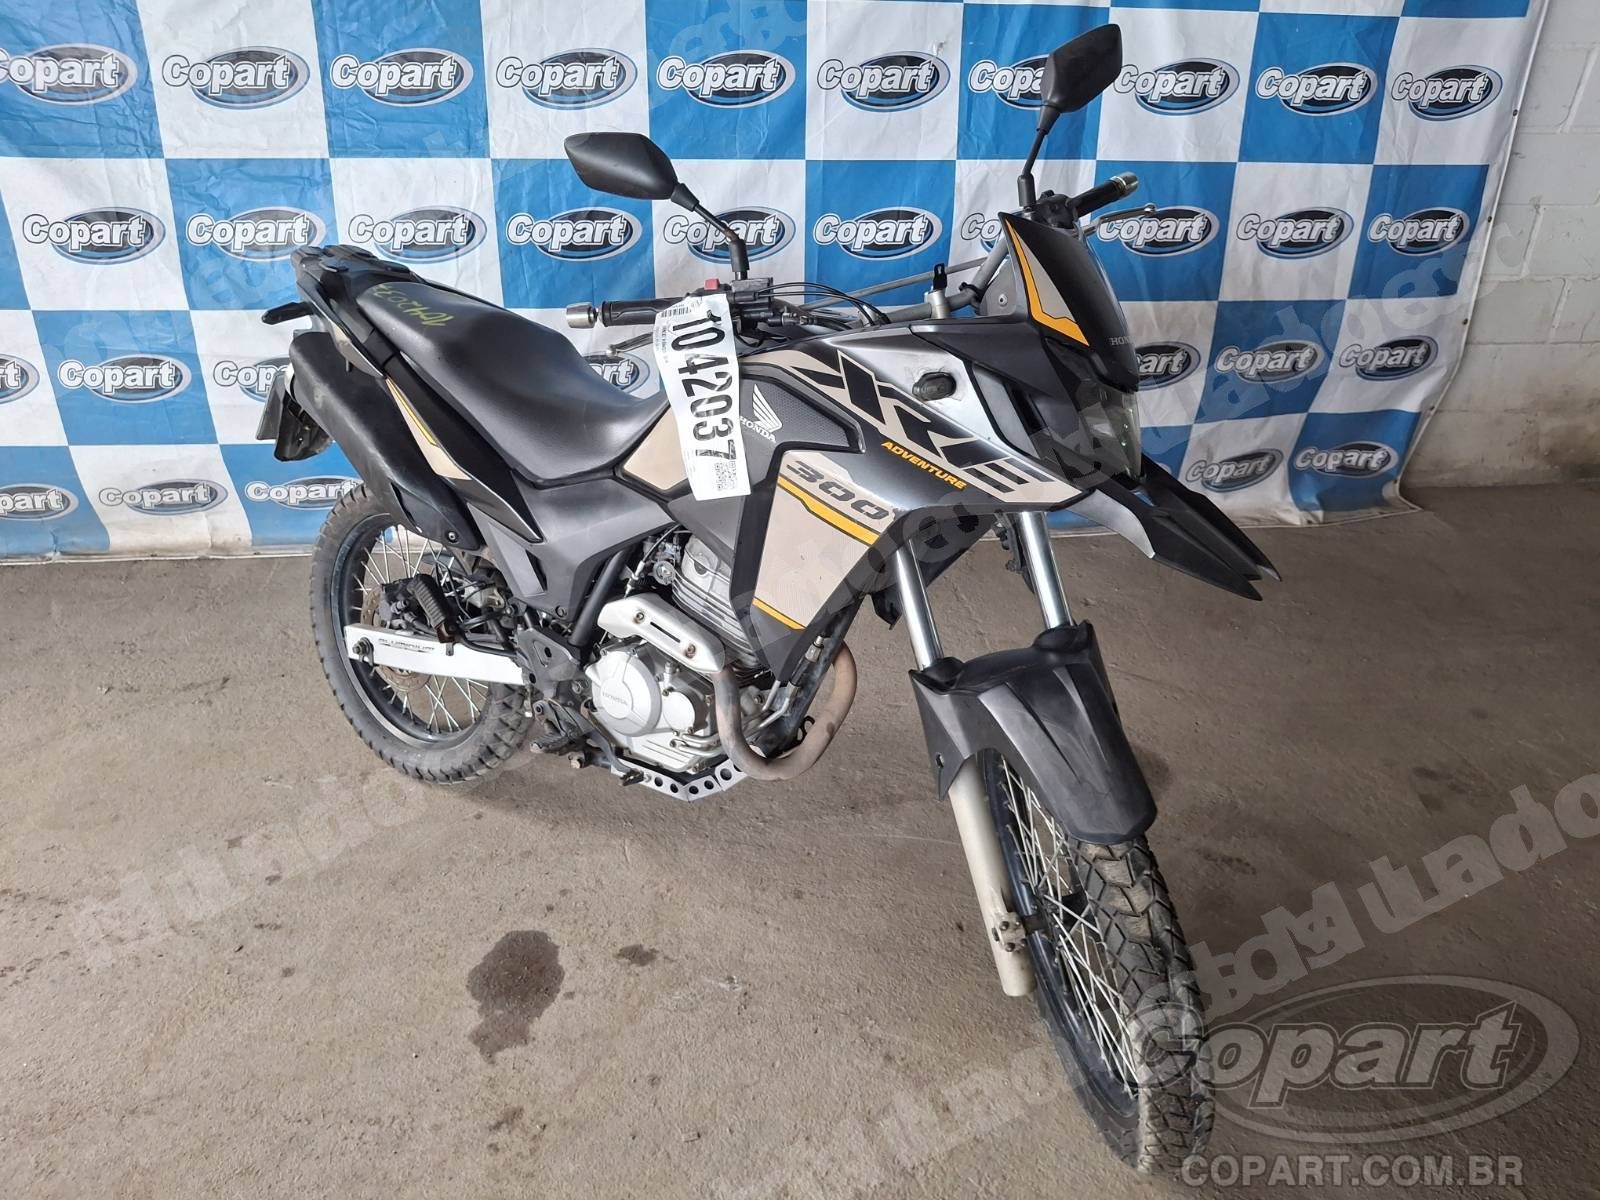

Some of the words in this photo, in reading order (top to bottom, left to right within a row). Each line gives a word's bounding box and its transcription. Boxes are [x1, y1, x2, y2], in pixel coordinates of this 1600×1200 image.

[162, 54, 291, 95] Copart
[330, 55, 457, 96] Copart
[496, 56, 618, 96] Copart
[656, 56, 780, 97] Copart
[817, 59, 935, 99] Copart
[968, 60, 1044, 100] Copa
[1113, 64, 1226, 102] Copart
[1255, 67, 1369, 106] Copart
[1391, 72, 1488, 109] Copart
[23, 214, 145, 251] Copart
[186, 213, 310, 252] Copart
[348, 214, 469, 251] Copart
[506, 213, 627, 251] Copart
[813, 213, 930, 251] Copart
[1097, 214, 1208, 248] Copart
[1236, 213, 1342, 247] Copart
[1368, 213, 1463, 248] Copart
[58, 359, 177, 393] Copart
[1215, 346, 1317, 376] Copart
[1338, 344, 1428, 373] Copart
[671, 309, 737, 461] 1042037
[740, 415, 777, 444] HONDA
[790, 350, 1055, 495] XRE
[880, 440, 968, 490] ADVENTURE
[1185, 454, 1269, 486] Copart
[1294, 446, 1392, 472] Copart
[0, 488, 64, 516] part
[99, 483, 211, 508] Copart
[786, 460, 890, 520] 300
